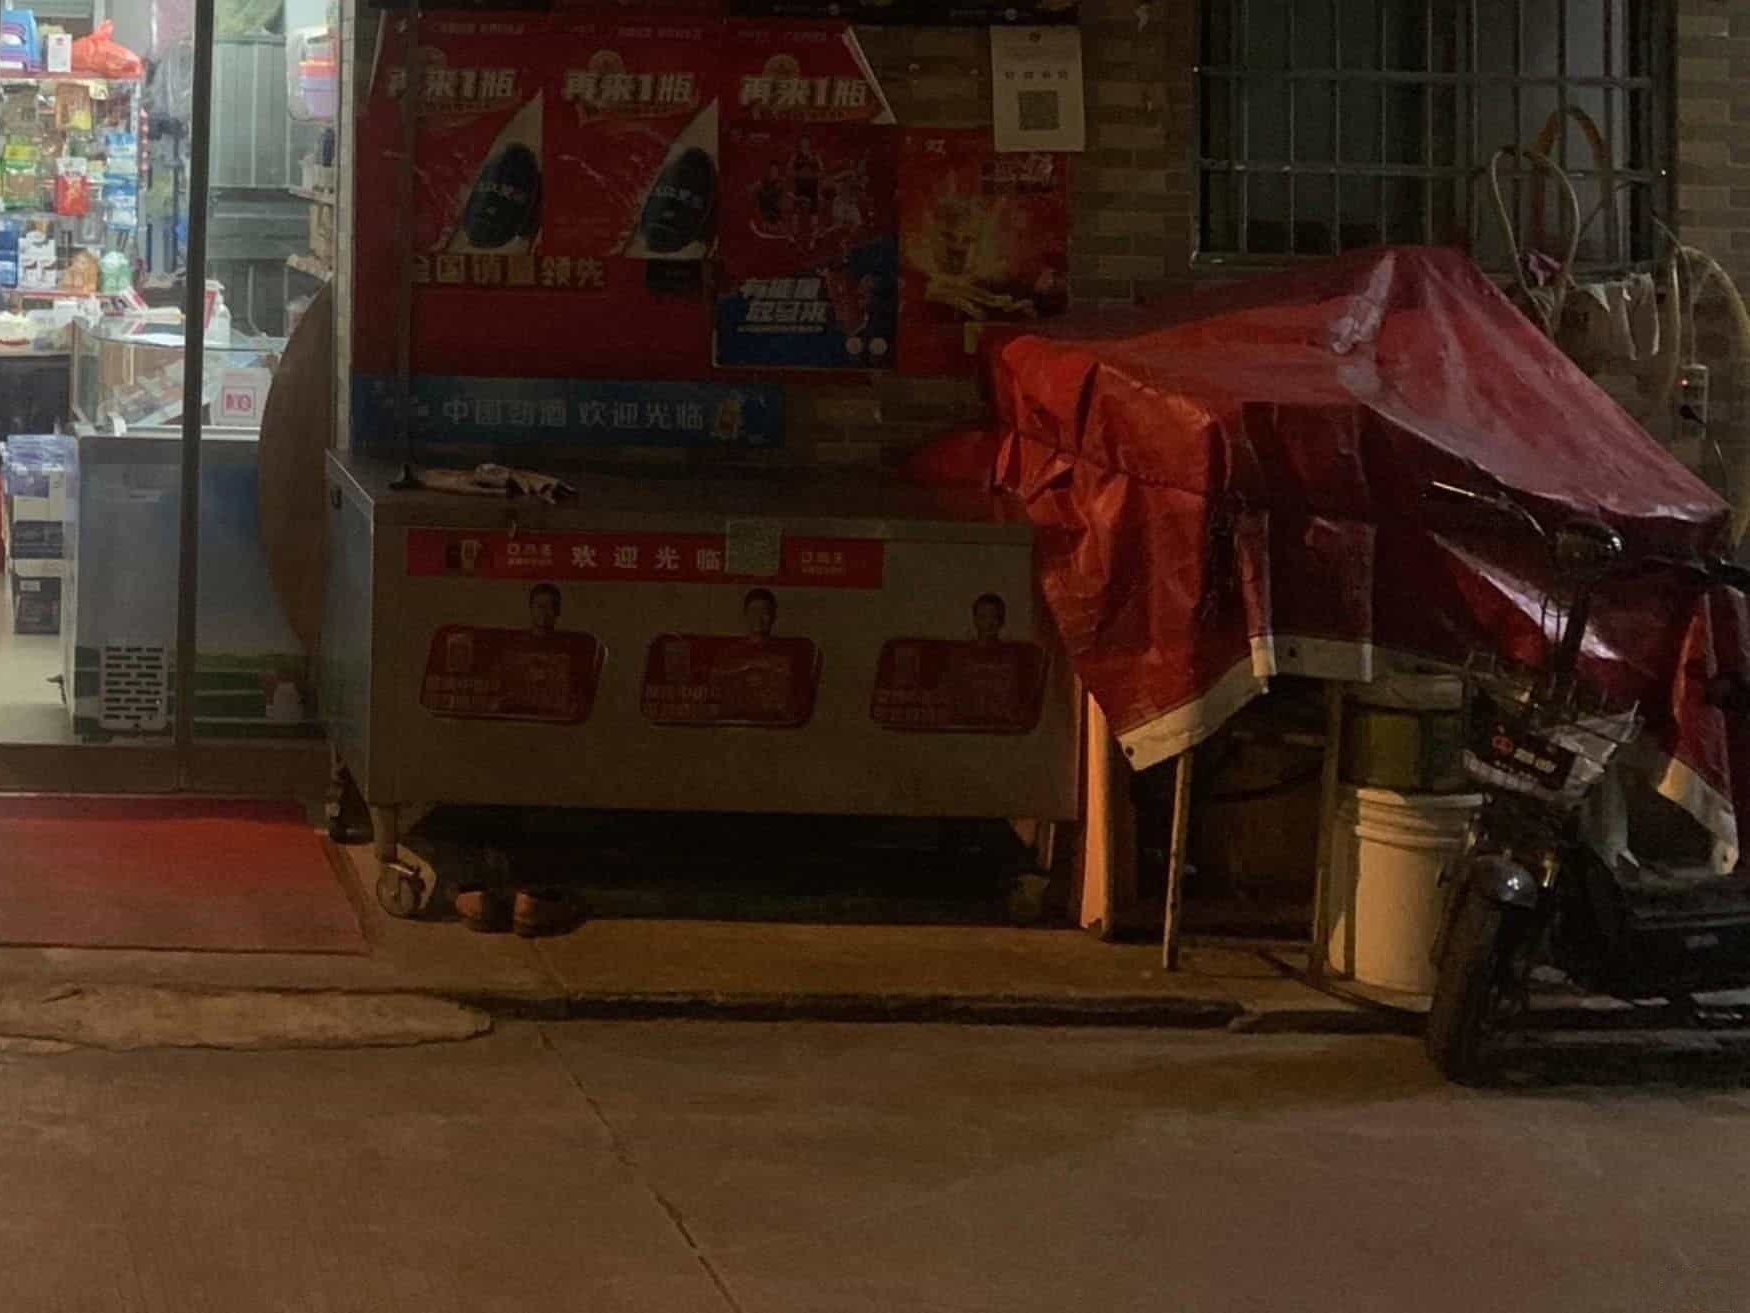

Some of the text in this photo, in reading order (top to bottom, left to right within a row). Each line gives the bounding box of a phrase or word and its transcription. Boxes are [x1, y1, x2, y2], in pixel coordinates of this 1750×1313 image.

[561, 69, 695, 102] 再来1瓶
[738, 74, 868, 108] 再来1瓶
[578, 398, 704, 431] 欢迎光临
[571, 544, 722, 573] 欢迎光临
